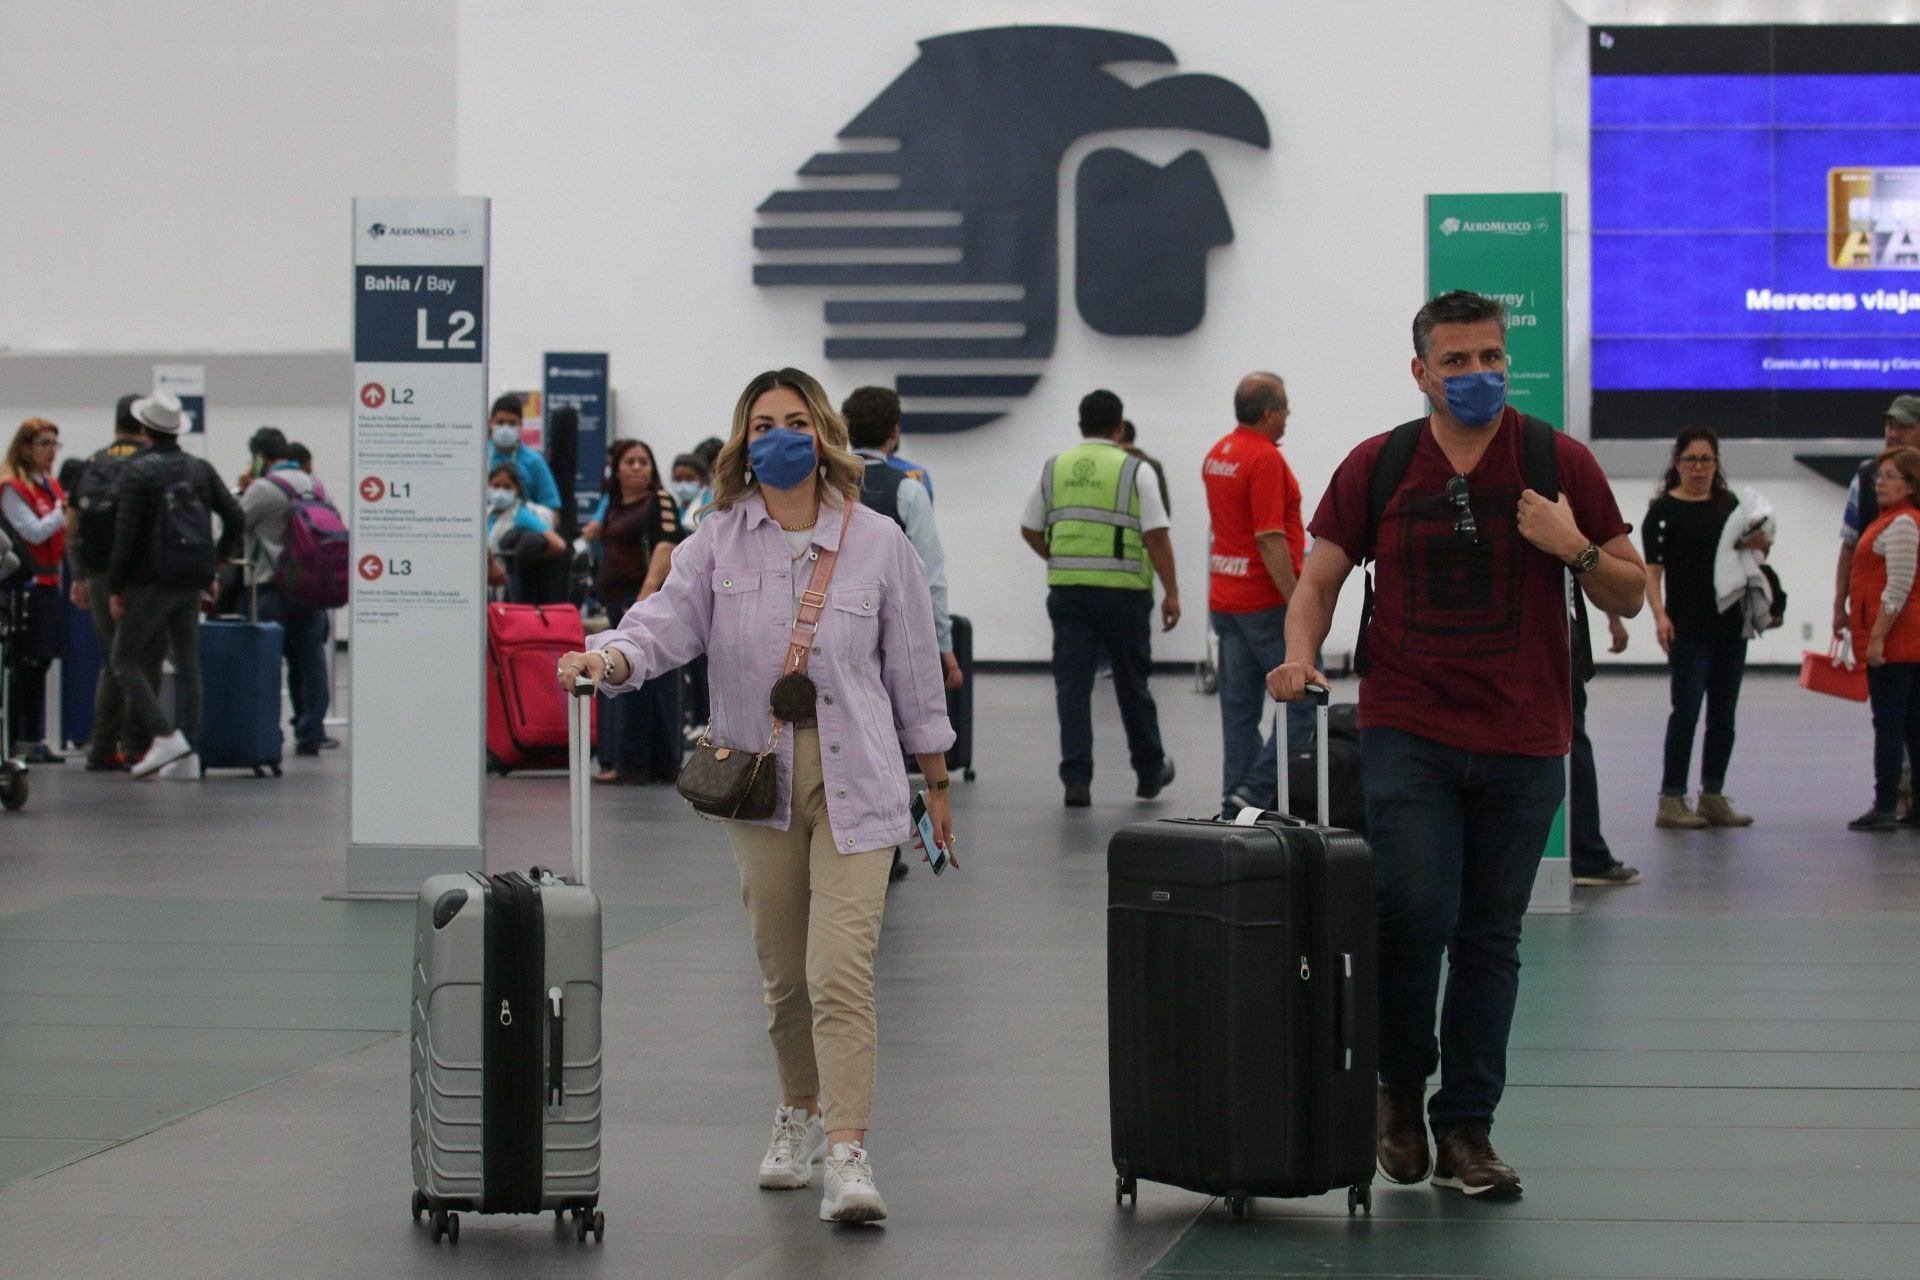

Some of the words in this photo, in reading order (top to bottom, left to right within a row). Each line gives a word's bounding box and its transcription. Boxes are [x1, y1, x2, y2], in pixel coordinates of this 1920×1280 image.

[427, 275, 456, 295] Bay
[1746, 288, 1857, 310] Mereces
[417, 307, 476, 350] L2
[391, 388, 414, 404] L2
[390, 482, 411, 498] L1
[389, 559, 412, 576] L3
